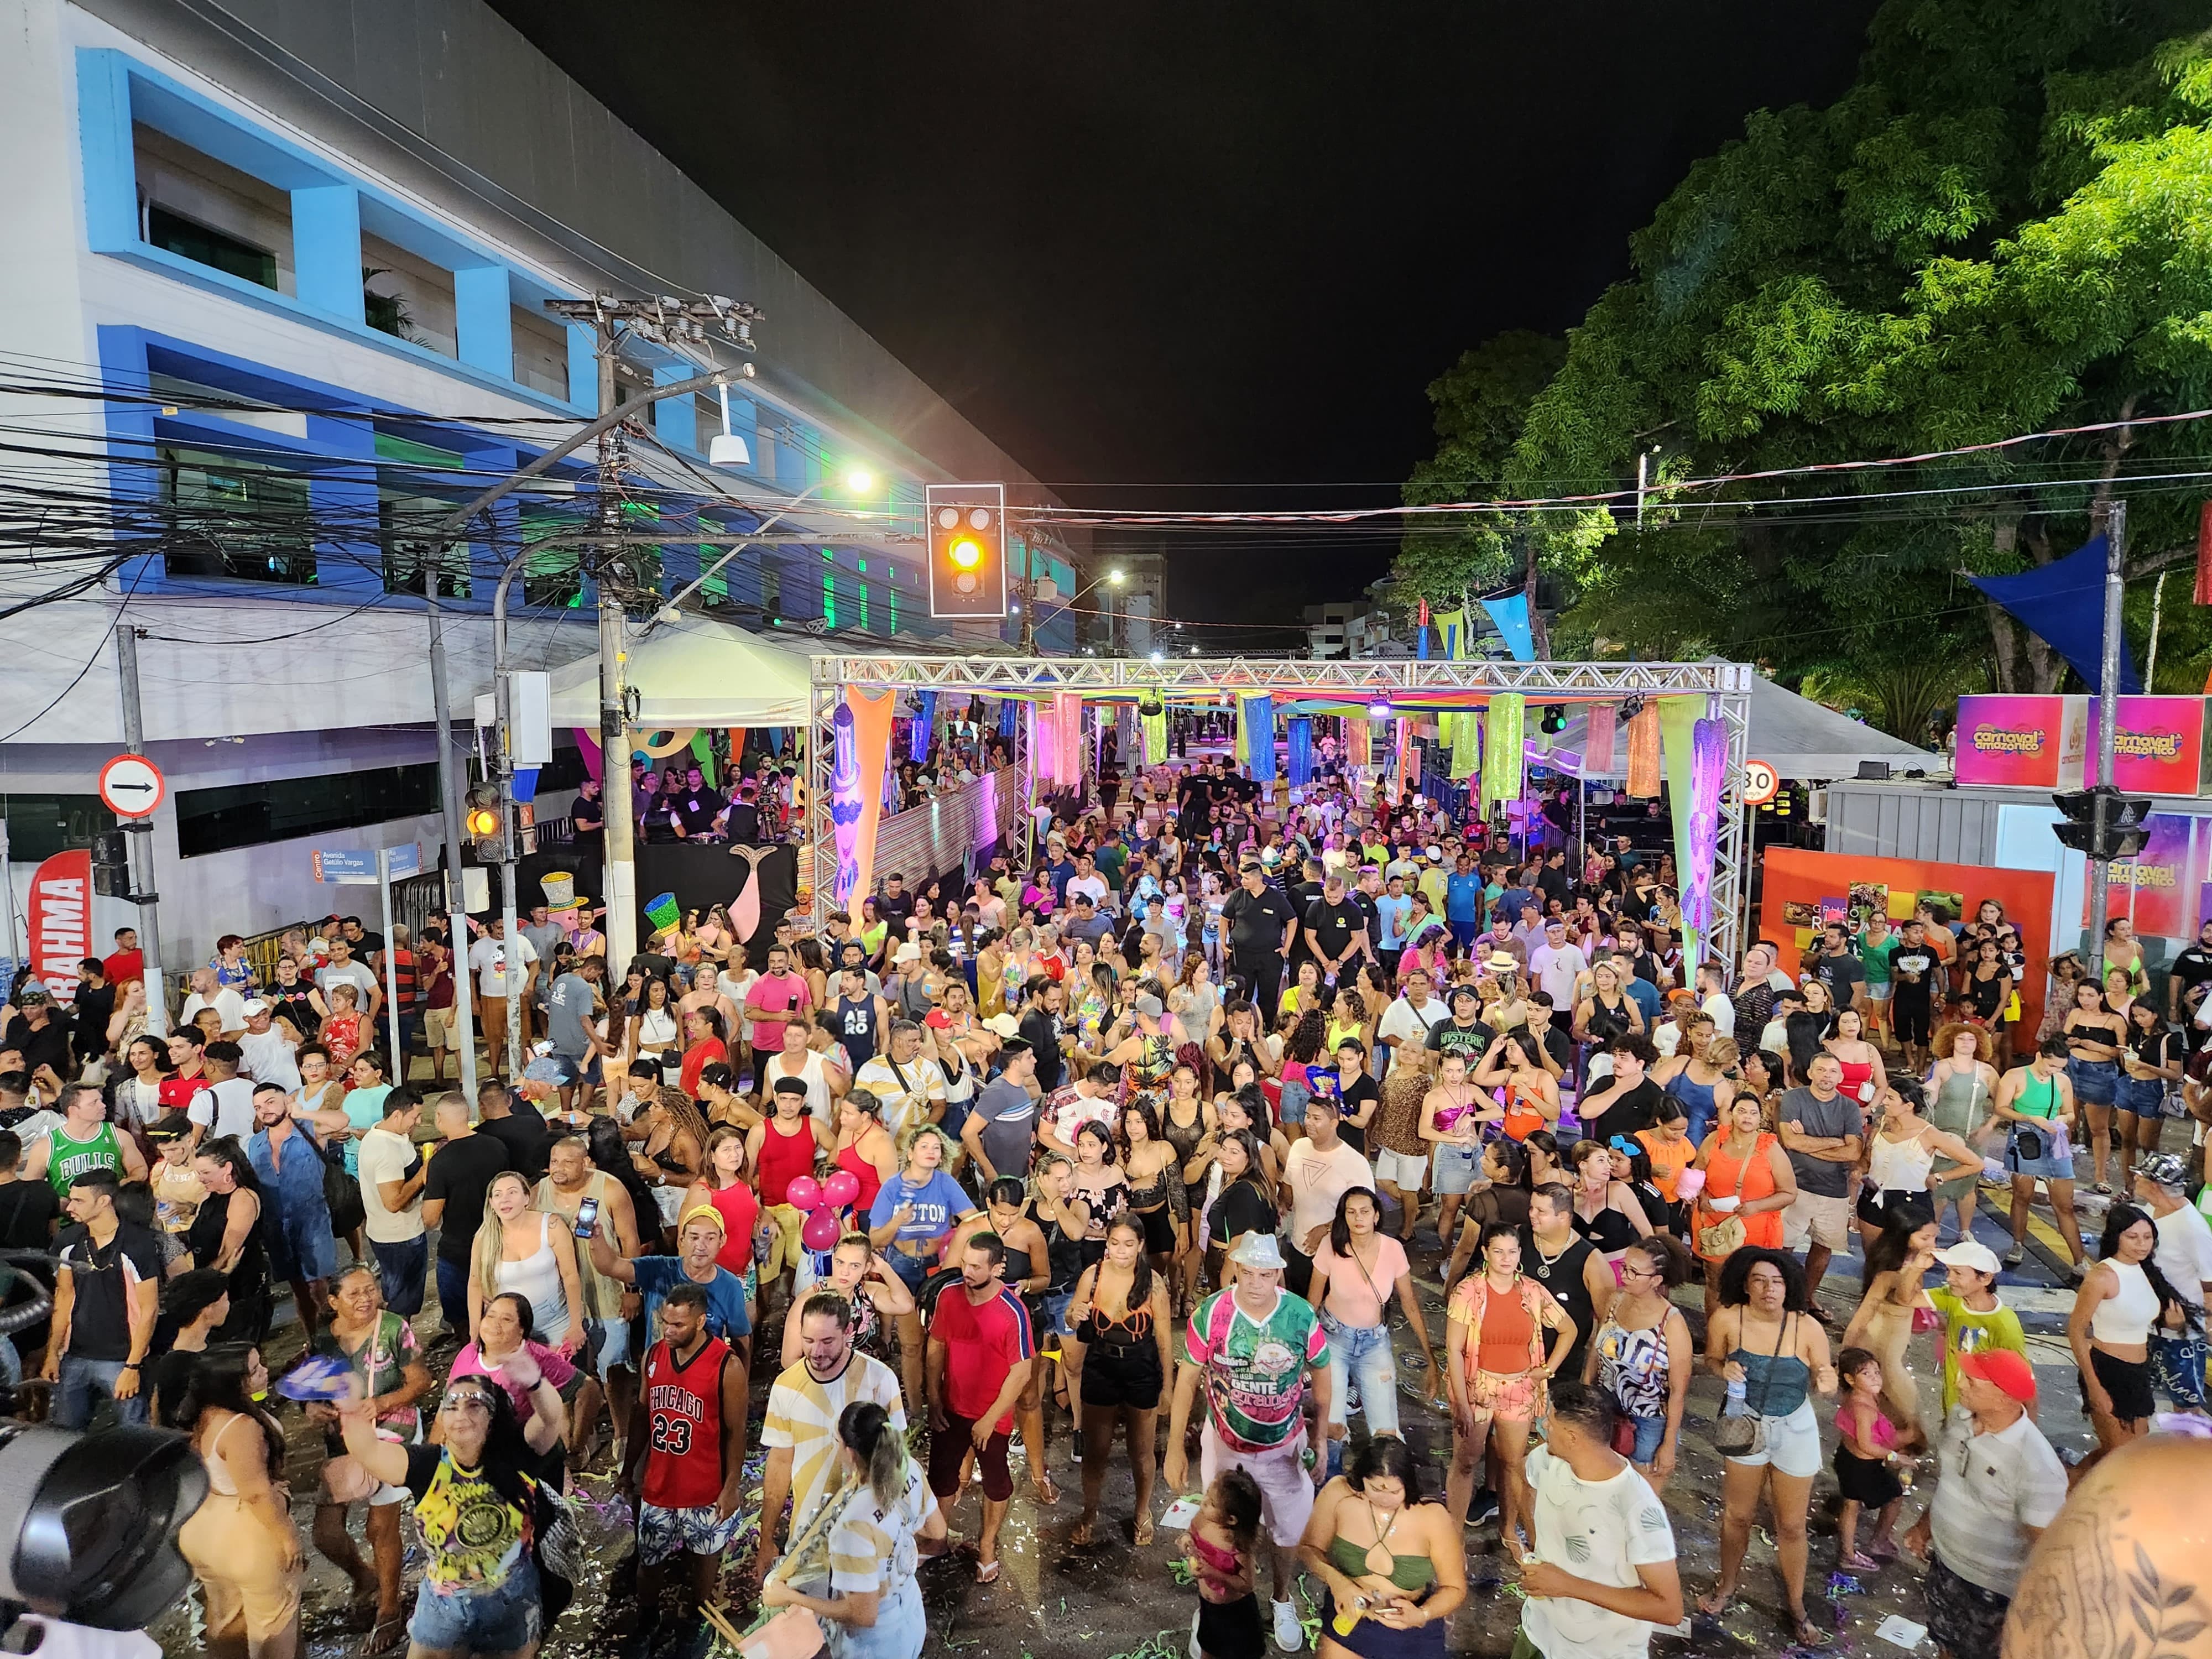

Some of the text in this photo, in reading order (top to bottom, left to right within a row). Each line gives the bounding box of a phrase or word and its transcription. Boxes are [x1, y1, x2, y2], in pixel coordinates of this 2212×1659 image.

[1973, 731, 2038, 744] carnaval
[2114, 734, 2176, 748] arnaval
[345, 859, 363, 867] Vargas
[2107, 862, 2175, 878] arnaval
[39, 878, 84, 1015] RAHMA
[1440, 1031, 1485, 1048] MYSTERIO
[60, 1152, 115, 1181] BULLS
[893, 1203, 946, 1223] BSTON
[1213, 1353, 1248, 1366] História
[1231, 1378, 1277, 1395] GENTE
[651, 1413, 692, 1455] 23
